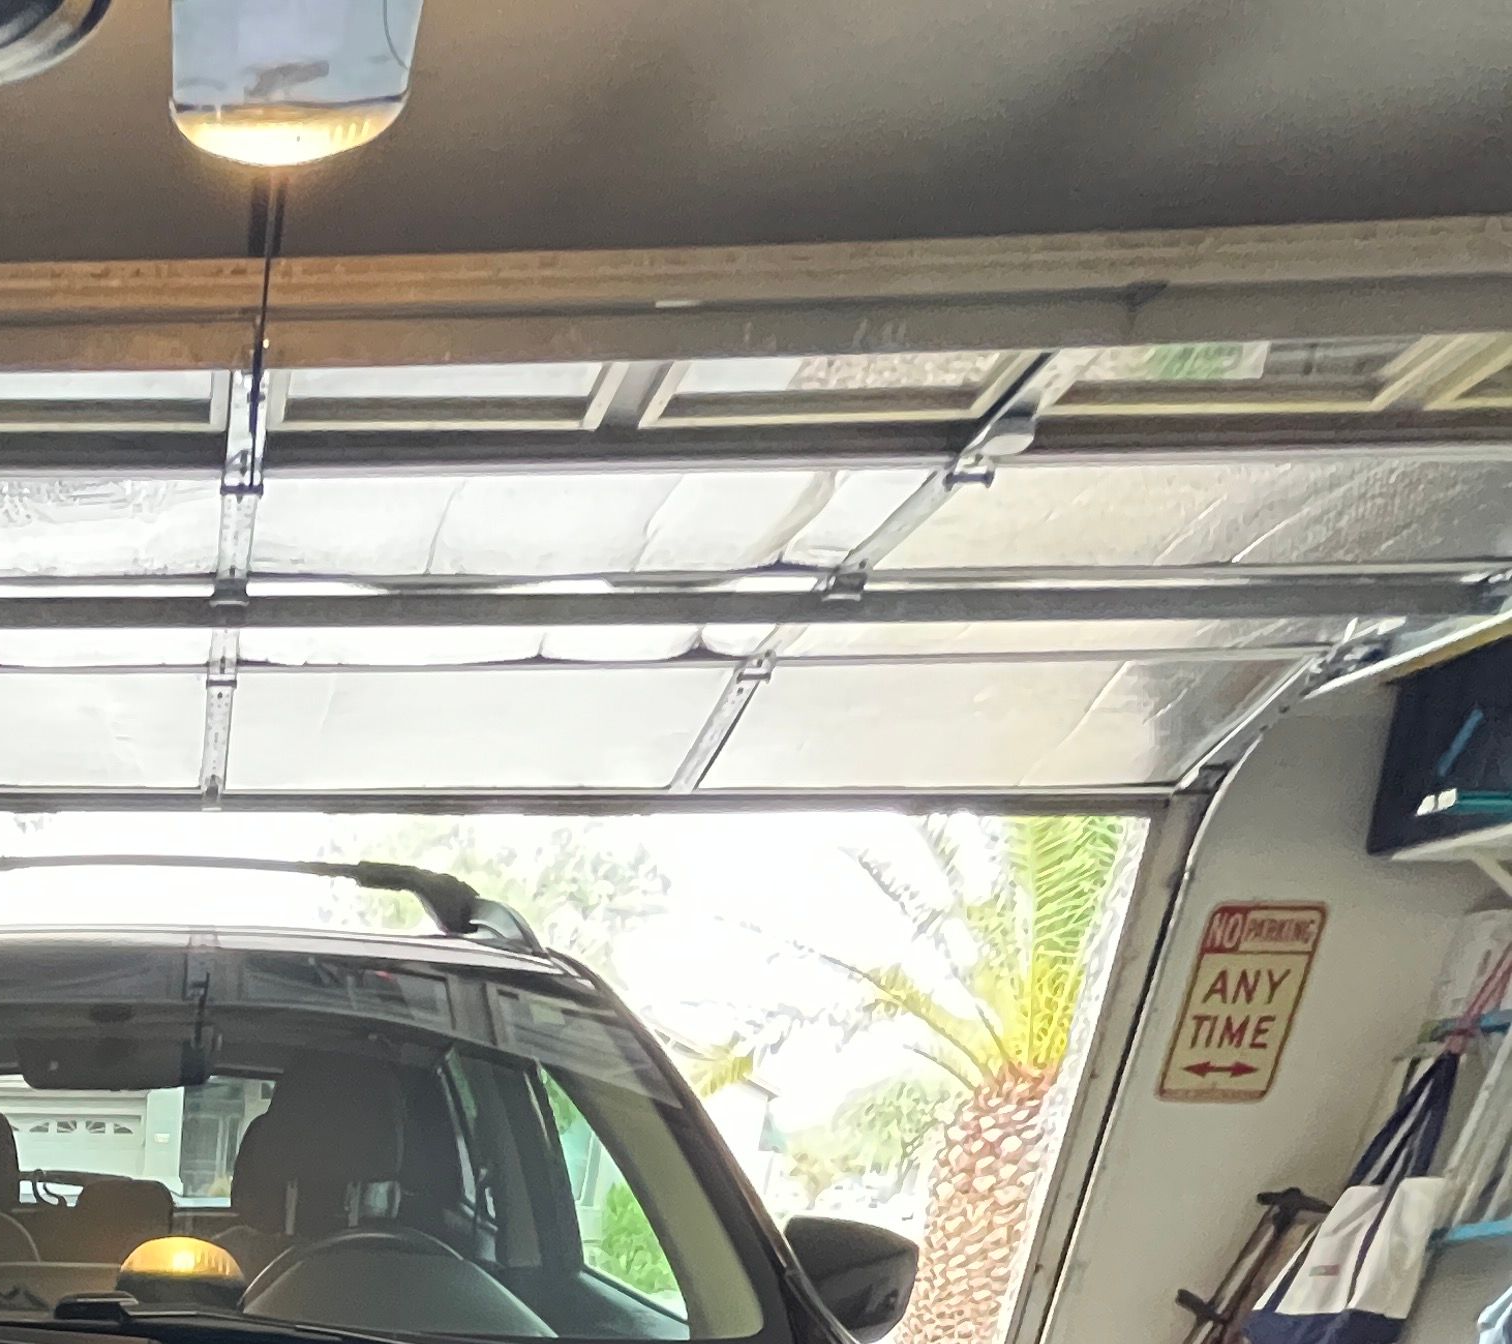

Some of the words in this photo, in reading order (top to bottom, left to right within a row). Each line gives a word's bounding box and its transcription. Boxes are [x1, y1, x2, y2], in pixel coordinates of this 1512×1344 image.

[1206, 911, 1244, 949] NO
[1202, 968, 1291, 1004] ANY
[1190, 1014, 1276, 1049] TIME
